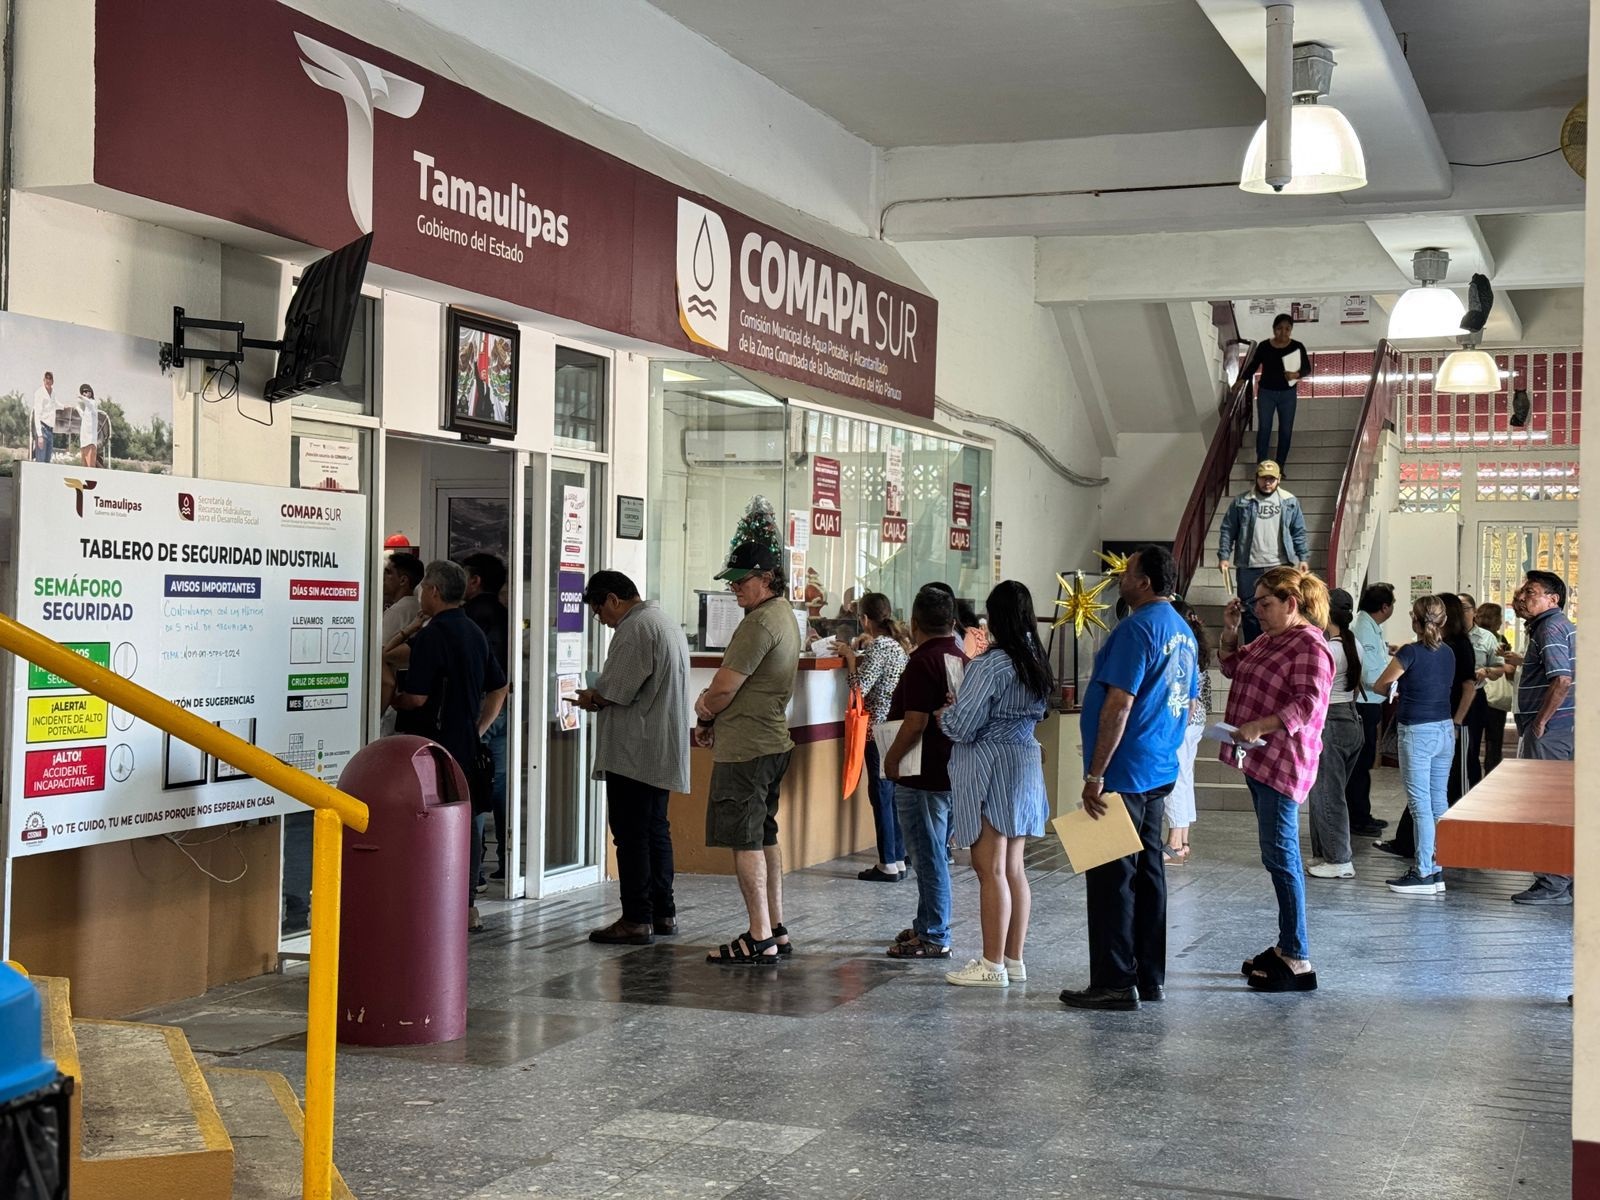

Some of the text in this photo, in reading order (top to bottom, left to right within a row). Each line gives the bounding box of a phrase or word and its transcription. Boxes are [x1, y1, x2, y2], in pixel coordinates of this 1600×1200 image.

[413, 150, 569, 248] Tamaulipas
[417, 214, 523, 263] Gobierno del Estado
[739, 232, 918, 363] COMAPA SUR
[740, 309, 889, 375] Comisión Municipal de Agua Potable y Alcantarillado
[739, 333, 902, 401] de la Zona Conurbada de la Desembocadura del Río Pánuco
[94, 496, 142, 513] Tamaulipas
[198, 495, 232, 506] Secretaría de
[198, 504, 222, 514] Recursos
[281, 504, 342, 521] COMAPA SUR
[1257, 505, 1280, 515] UESS
[244, 515, 259, 525] Social
[814, 513, 834, 535] CAJA
[835, 515, 840, 533] 1
[884, 521, 906, 541] CAJA 2
[951, 531, 970, 550] CAJA 3
[80, 538, 339, 569] TABLERO DE SEGURIDAD INDUSTRIAL
[34, 573, 122, 598] SEMÁFORO
[170, 581, 256, 593] AVISOS IMPORTANTES
[292, 584, 357, 597] DÍAS SIN ACCIDENTES
[560, 592, 583, 603] CODIGO
[42, 602, 133, 621] SEGURIDAD
[563, 603, 580, 614] ADAM
[292, 616, 324, 625] LLEVAMOS
[331, 616, 355, 625] RECORD
[332, 631, 351, 655] 22
[291, 676, 347, 686] CRUZ DE SEGURIDAD
[51, 701, 87, 713] ¡ALERTA!
[193, 698, 204, 707] DE
[205, 695, 255, 707] SUGERENCIAS
[32, 713, 103, 726] INCIDENTE DE ALTO
[47, 725, 88, 736] POTENCIAL
[52, 751, 82, 765] ¡ALTO!
[43, 765, 88, 779] ACCIDENTE
[33, 775, 95, 791] INCAPACITANTE
[51, 796, 275, 835] YO TE CUIDO, TU ME CUIDAS PORQUE NOS ESPERAN EN CASA
